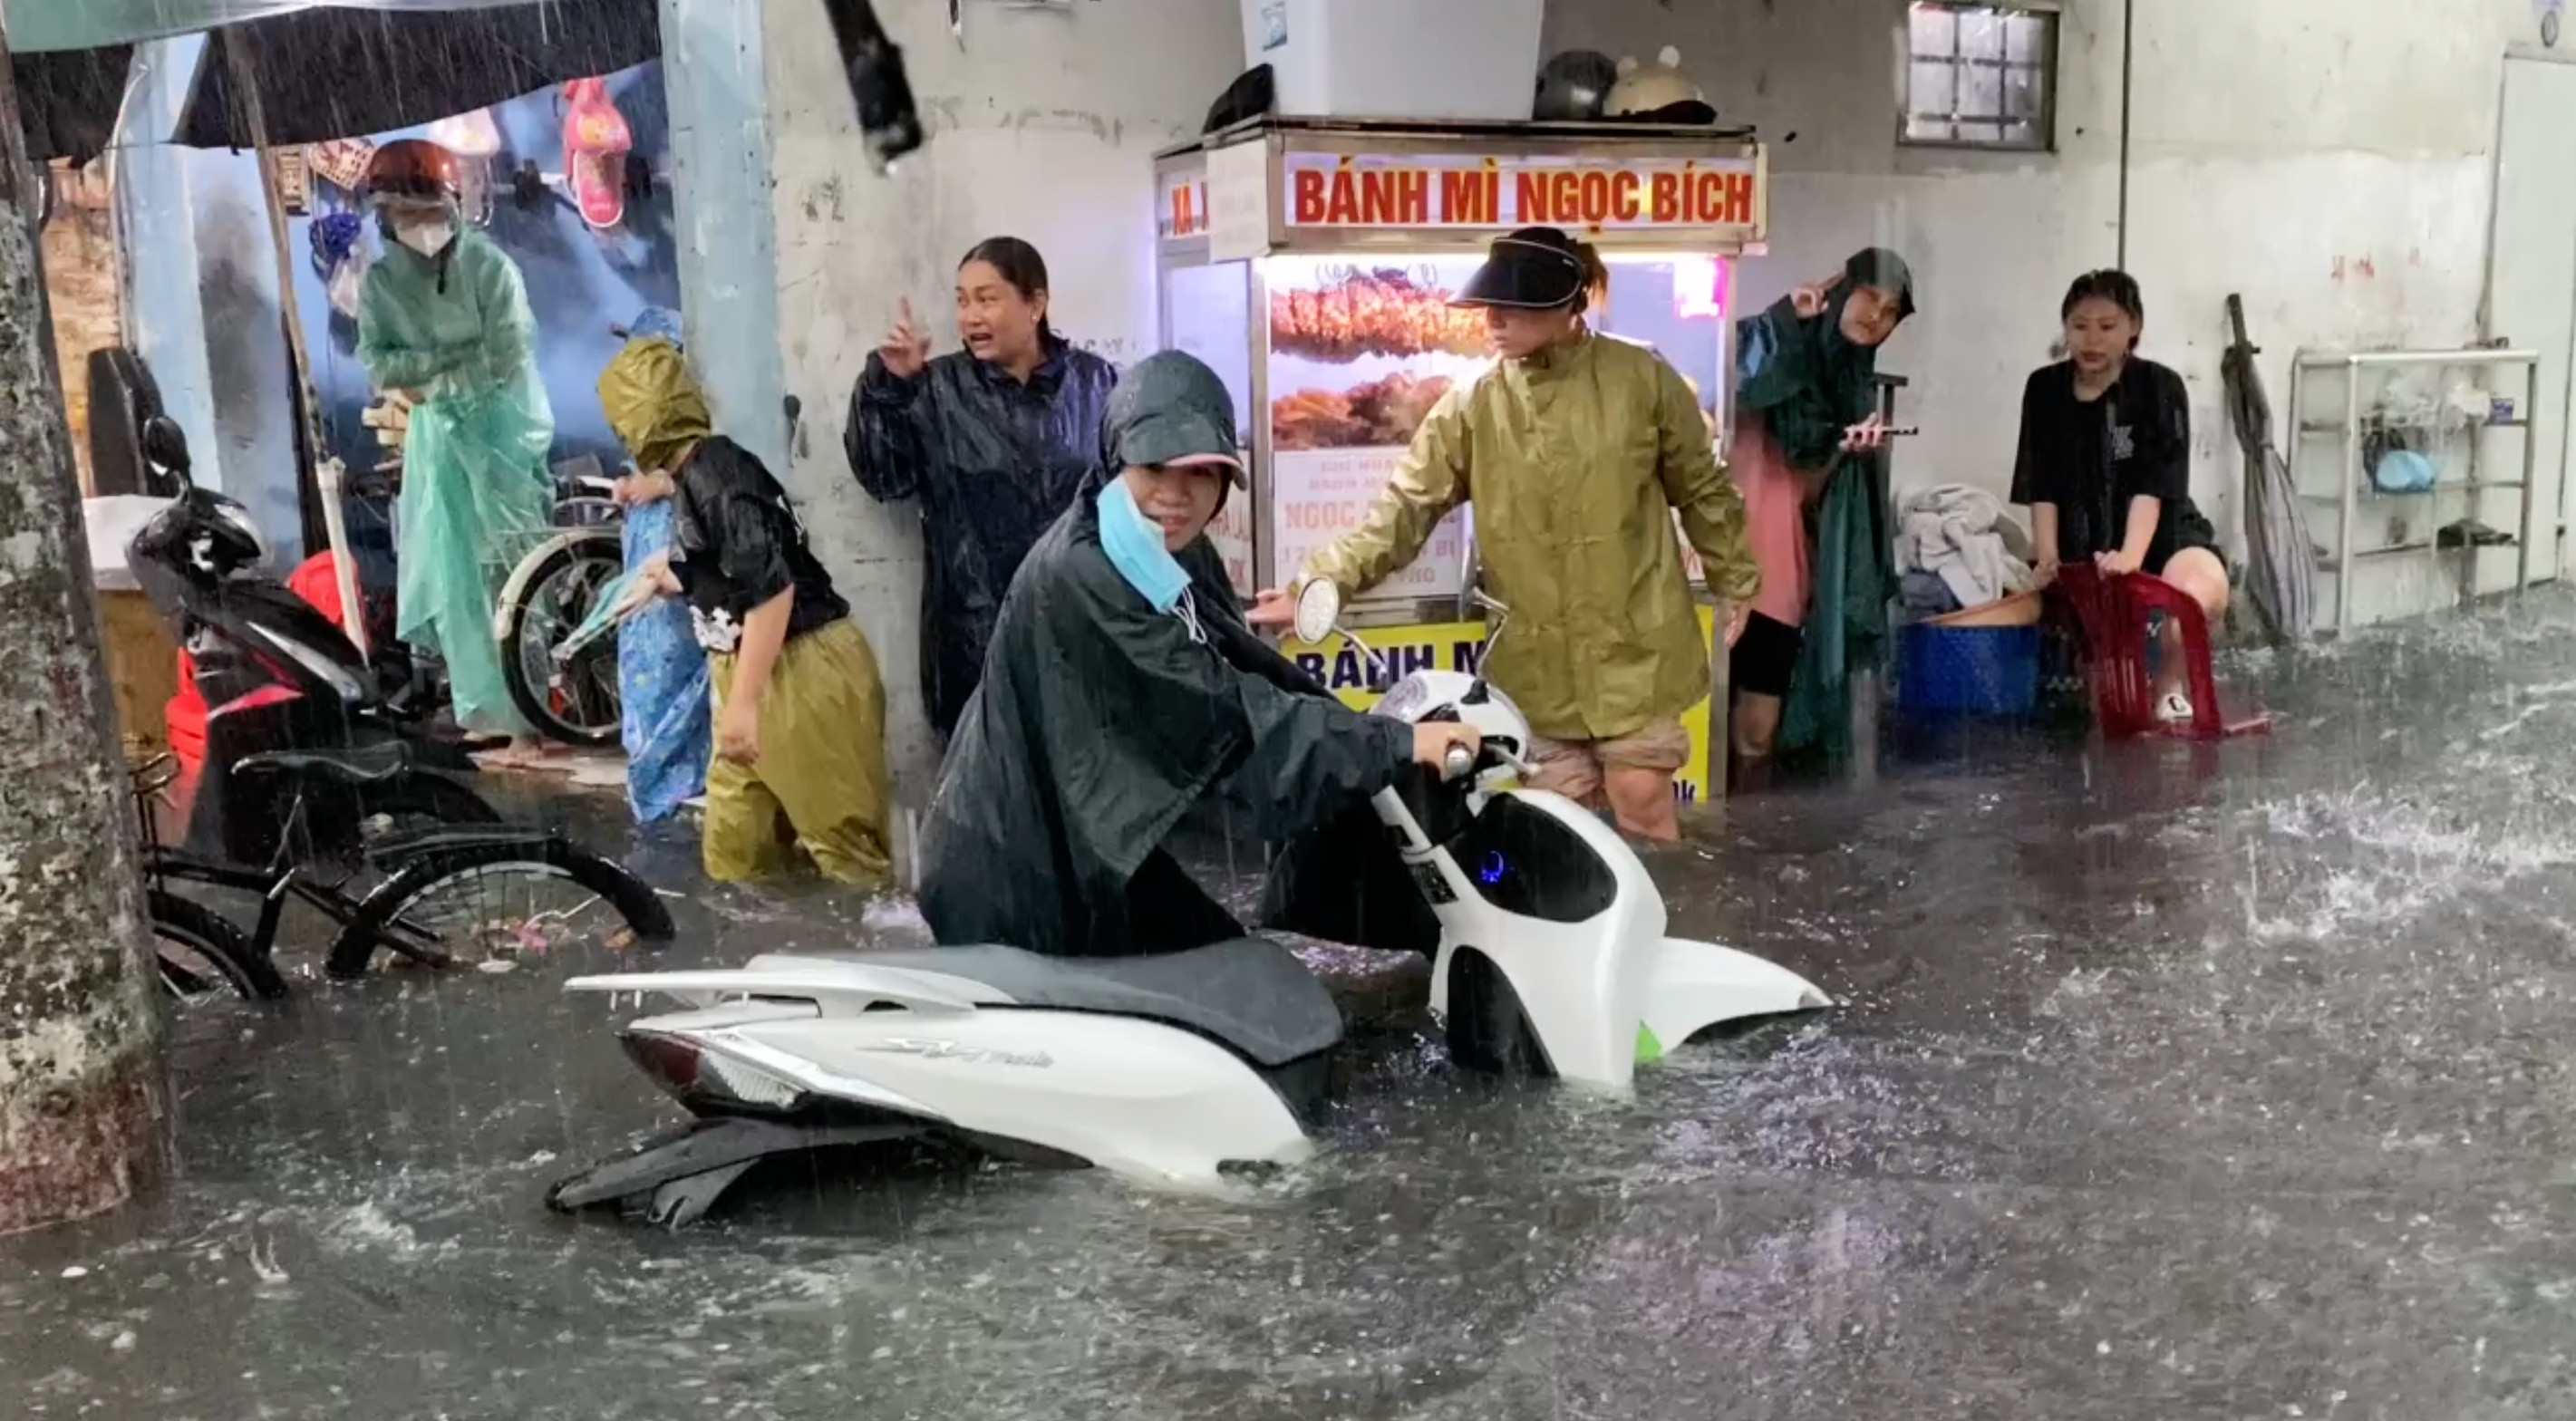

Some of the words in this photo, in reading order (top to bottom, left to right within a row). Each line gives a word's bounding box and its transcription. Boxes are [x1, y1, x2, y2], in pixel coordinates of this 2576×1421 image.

[1295, 156, 1428, 224] BÁNH
[1441, 157, 1500, 224] MÌ
[1516, 170, 1641, 234] NGỌC
[1651, 160, 1753, 224] BÍCH
[1296, 640, 1434, 689] BÁNH
[1454, 640, 1487, 676] M
